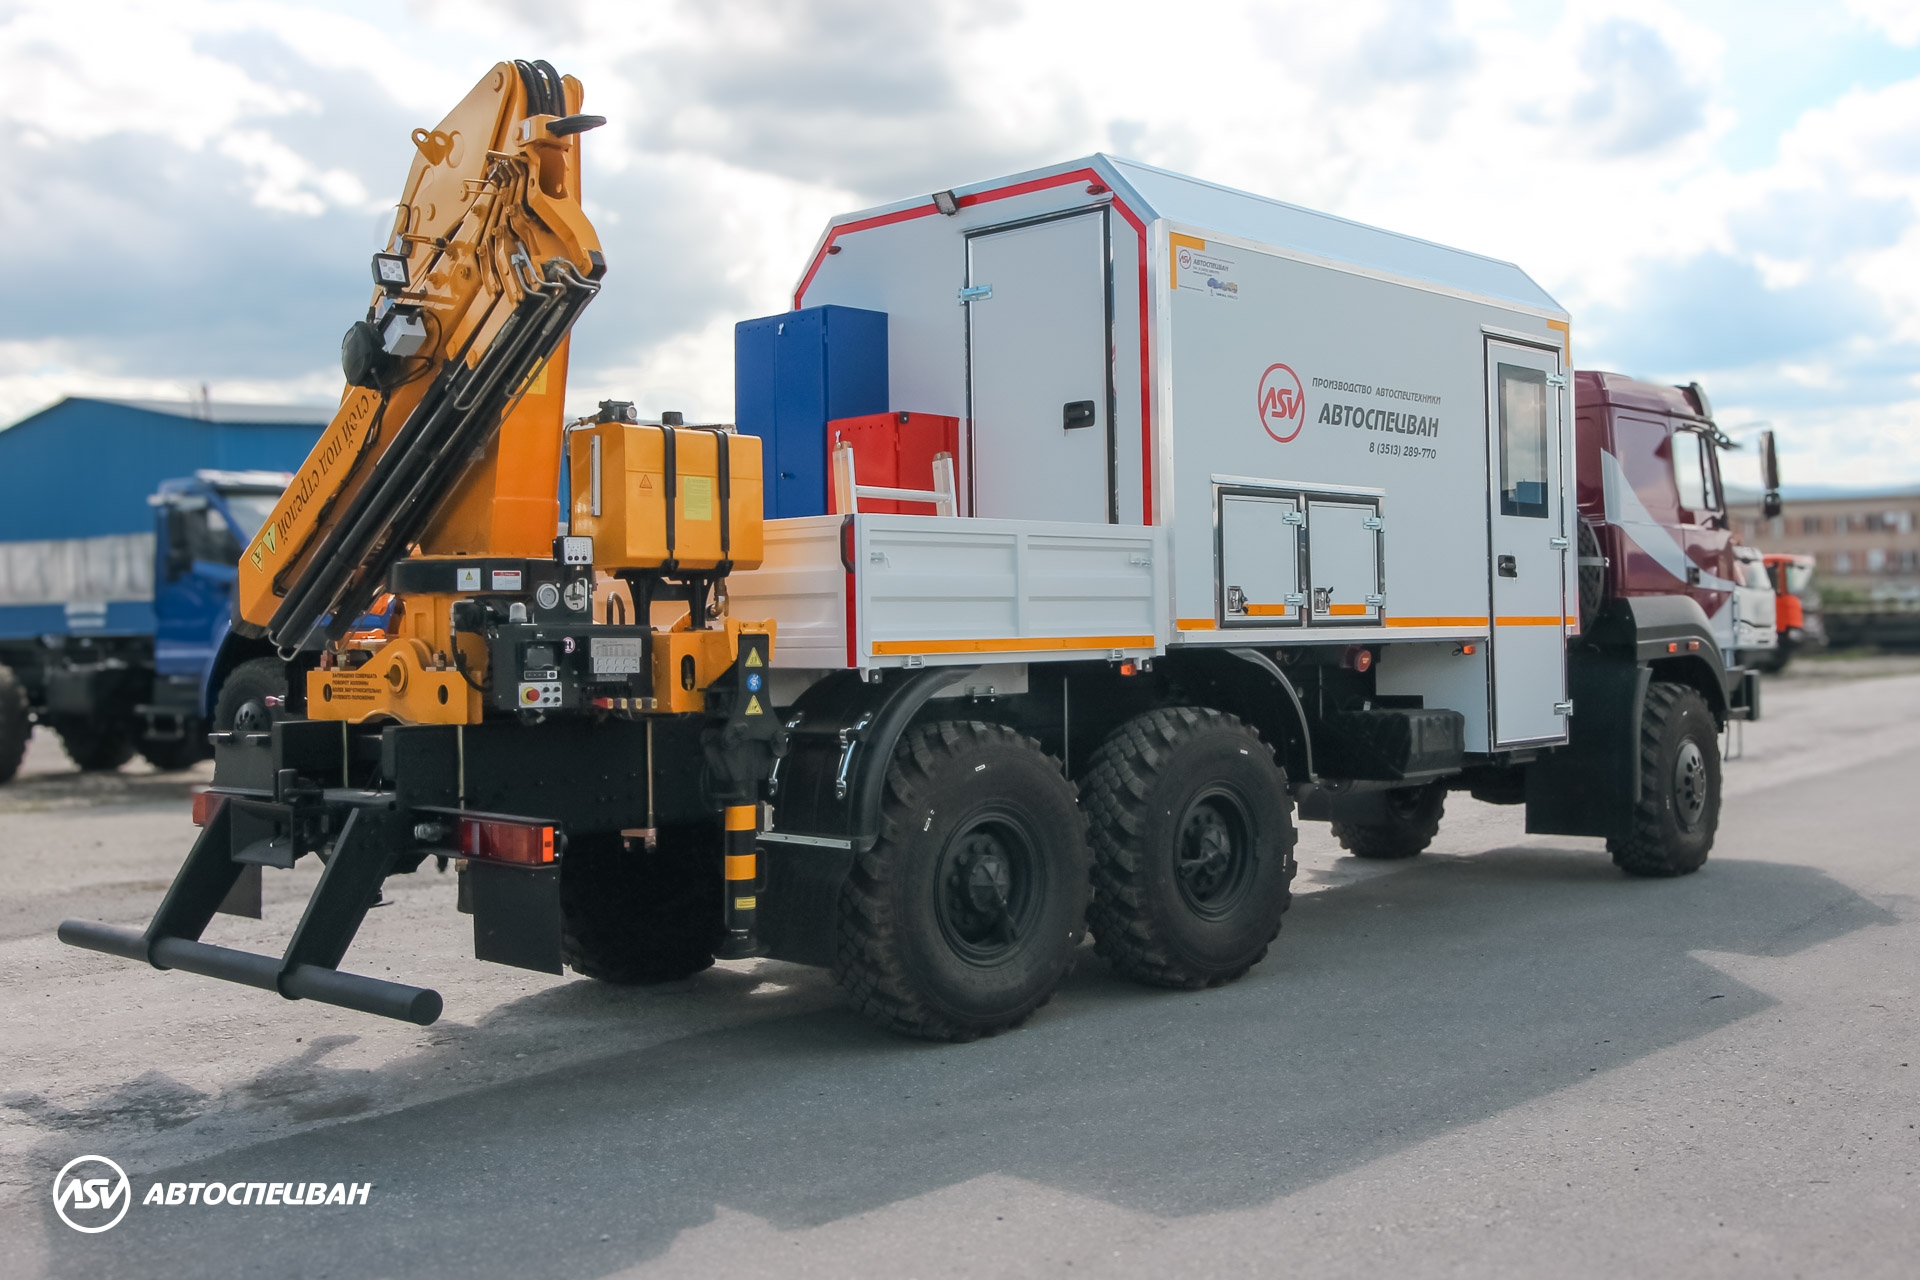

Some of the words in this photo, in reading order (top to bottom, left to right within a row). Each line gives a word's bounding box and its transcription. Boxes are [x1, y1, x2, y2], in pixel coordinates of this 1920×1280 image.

[1312, 377, 1372, 395] ПРОИЗВОДСТВО
[1375, 386, 1441, 405] АВТОСПЕЦТЕХНИКИ
[1318, 402, 1439, 438] АВТОСПЕЦВАН
[318, 435, 342, 475] под
[1369, 442, 1375, 453] 8
[1376, 442, 1401, 456] (3513)
[1403, 445, 1436, 459] 289-770
[277, 469, 320, 545] стрелой
